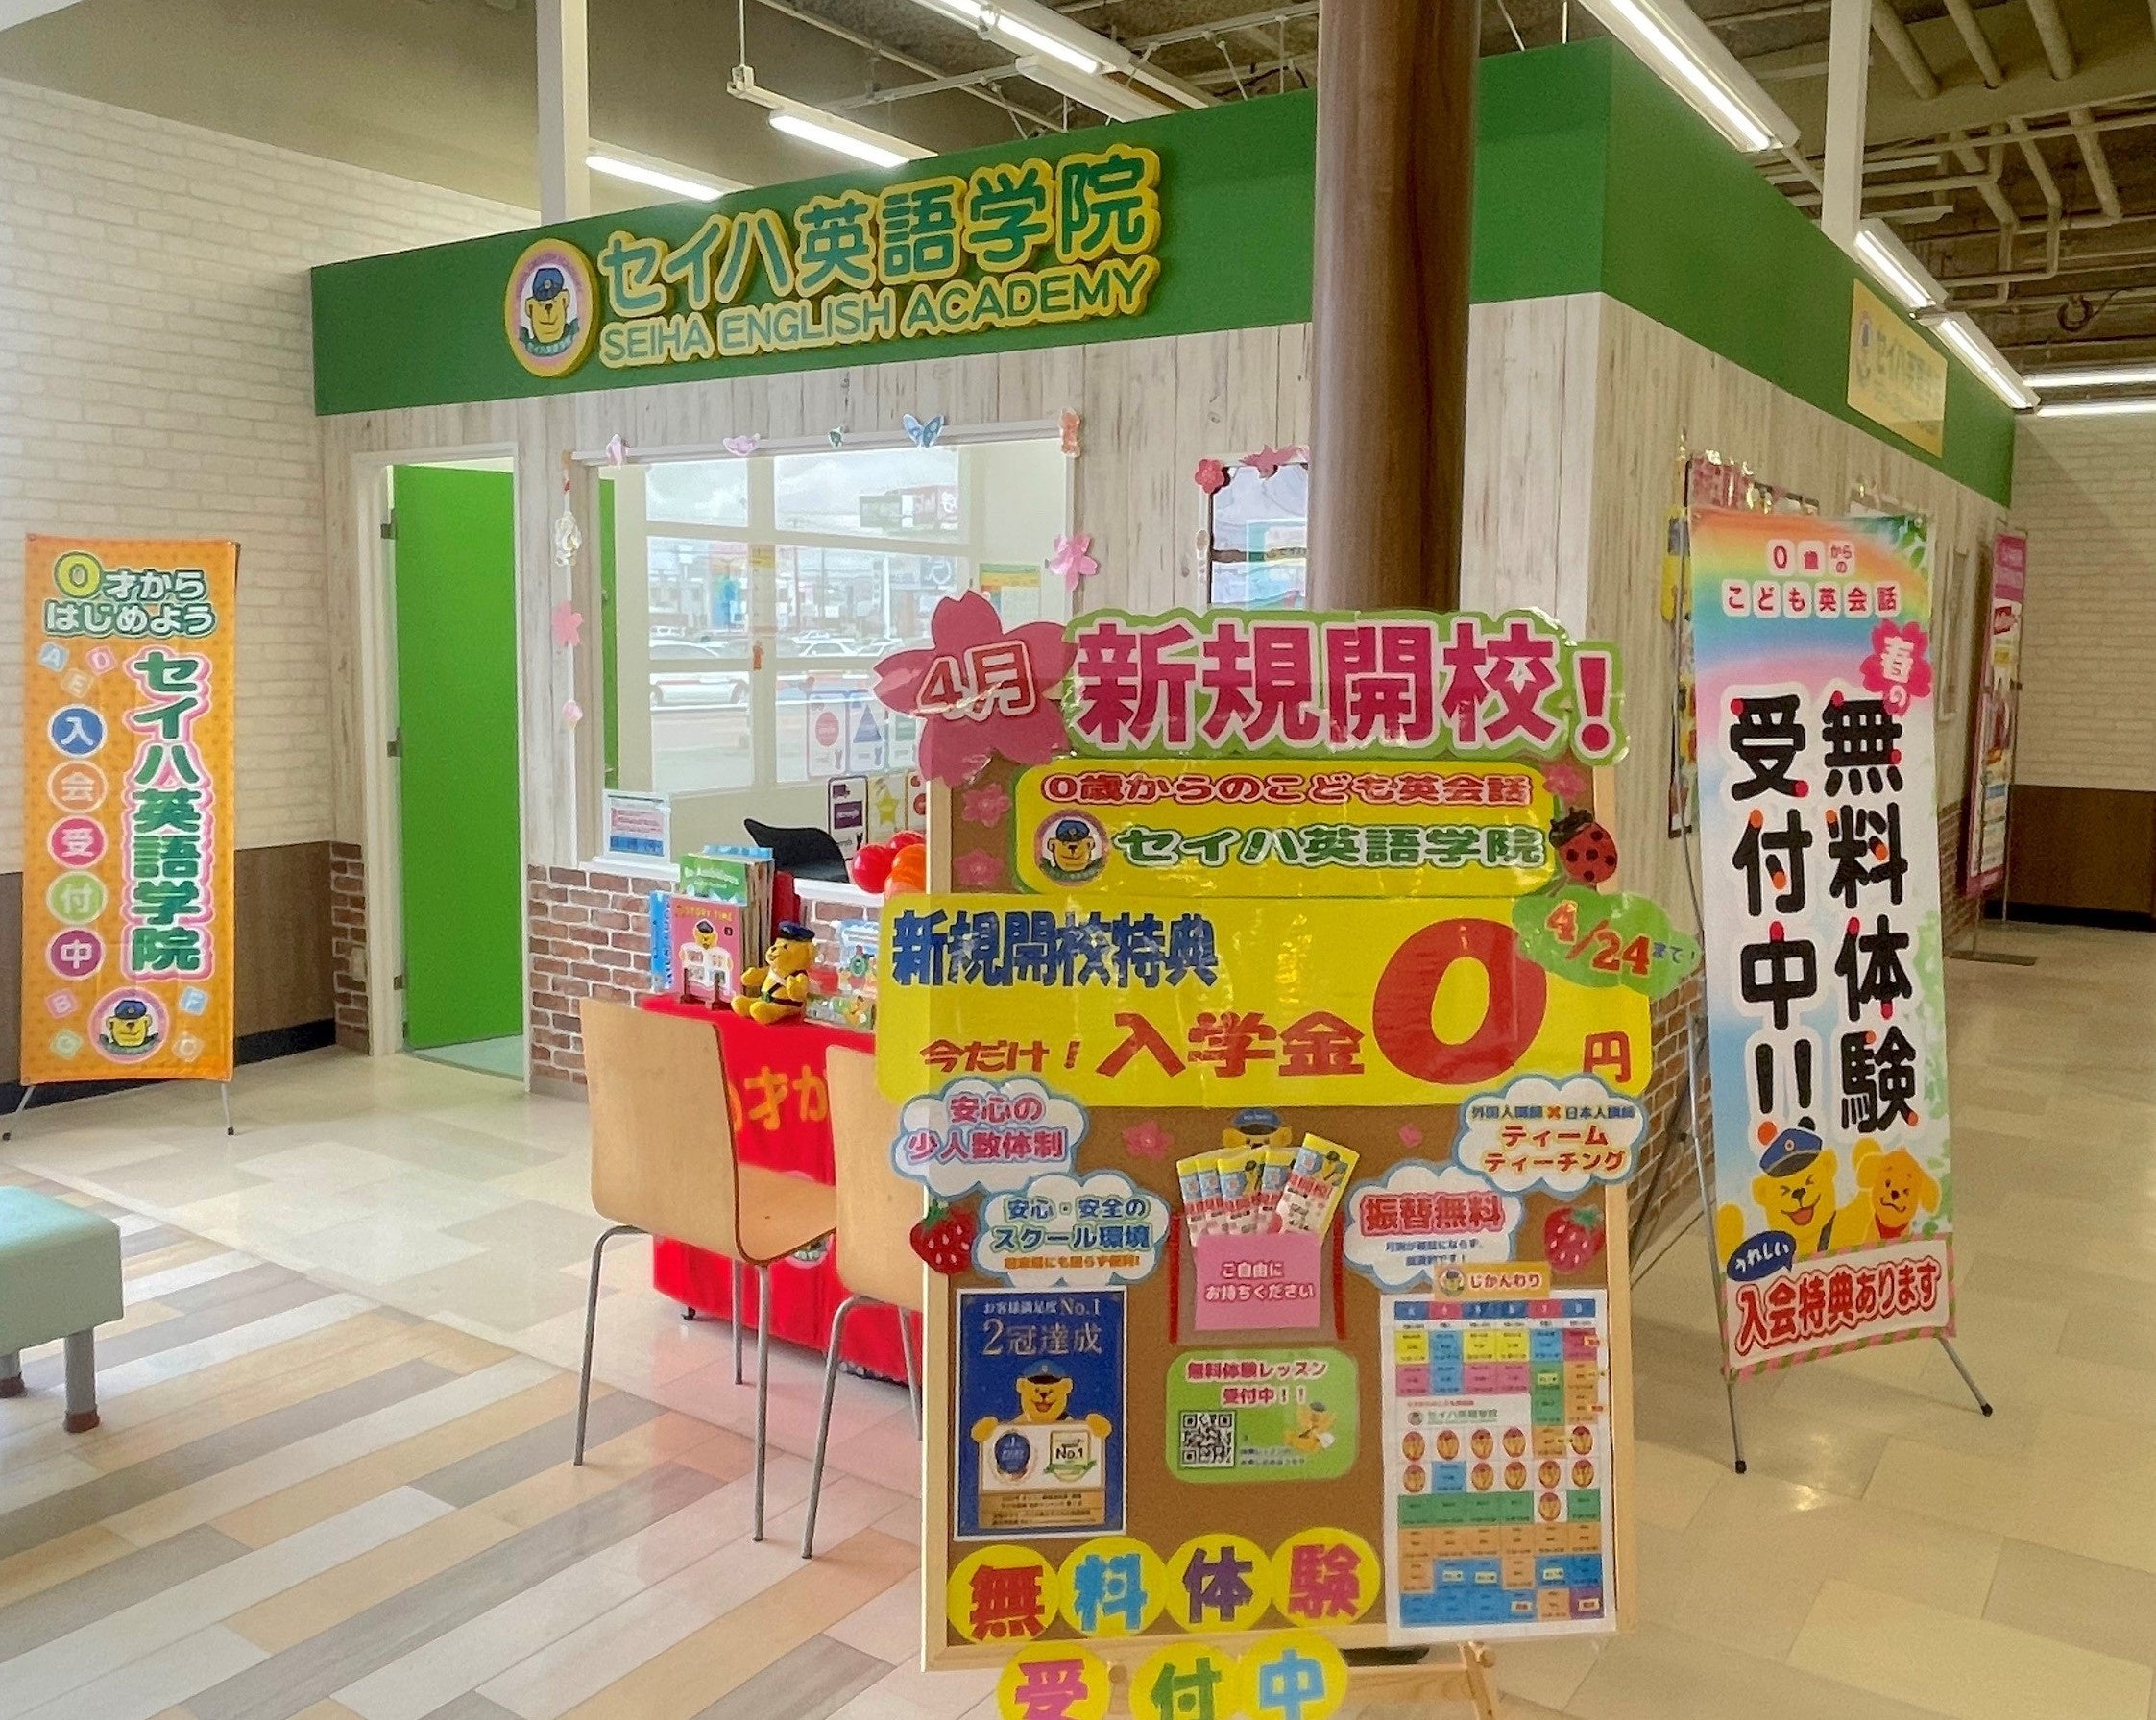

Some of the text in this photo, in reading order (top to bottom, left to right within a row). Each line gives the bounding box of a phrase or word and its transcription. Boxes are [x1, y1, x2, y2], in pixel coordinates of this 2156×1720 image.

[603, 156, 1150, 301] セイハ英語学院
[604, 266, 1151, 359] SEIHA ENGLISH ACADEMY
[1727, 585, 1899, 613] こども英会話
[46, 601, 215, 635] はじめよう
[918, 642, 1036, 720] 4月
[1879, 635, 1914, 712] 春の
[1043, 772, 1534, 807] 0歳からのこども英会話
[132, 651, 203, 972] セイハ英語学院
[59, 716, 95, 968] 入会受付中
[1116, 824, 1544, 868] セイハ英語学院
[1821, 690, 1920, 1134] 無料体験
[892, 909, 1219, 988] 新規開校特典
[950, 1095, 1046, 1123] 安心の
[908, 1130, 1064, 1161] 少人数体制
[1502, 1125, 1609, 1148] ティーム
[1485, 1150, 1626, 1173] ティーチング
[1006, 1197, 1147, 1221] 安心・安全の
[1363, 1194, 1503, 1230] 振替無料
[994, 1225, 1151, 1249] スクール環境
[1222, 1261, 1284, 1278] ご自由に
[1734, 1241, 1791, 1272] うれしい
[1205, 1283, 1315, 1301] お持ちください
[1470, 1272, 1542, 1289] じかんわり
[1736, 1259, 1939, 1354] 入会特典あります
[982, 1317, 1102, 1355] 2冠達成
[1188, 1361, 1327, 1379] 無料体験レッスン
[969, 1543, 1362, 1641] 無料体験
[1014, 1648, 1326, 1720] 受付中
